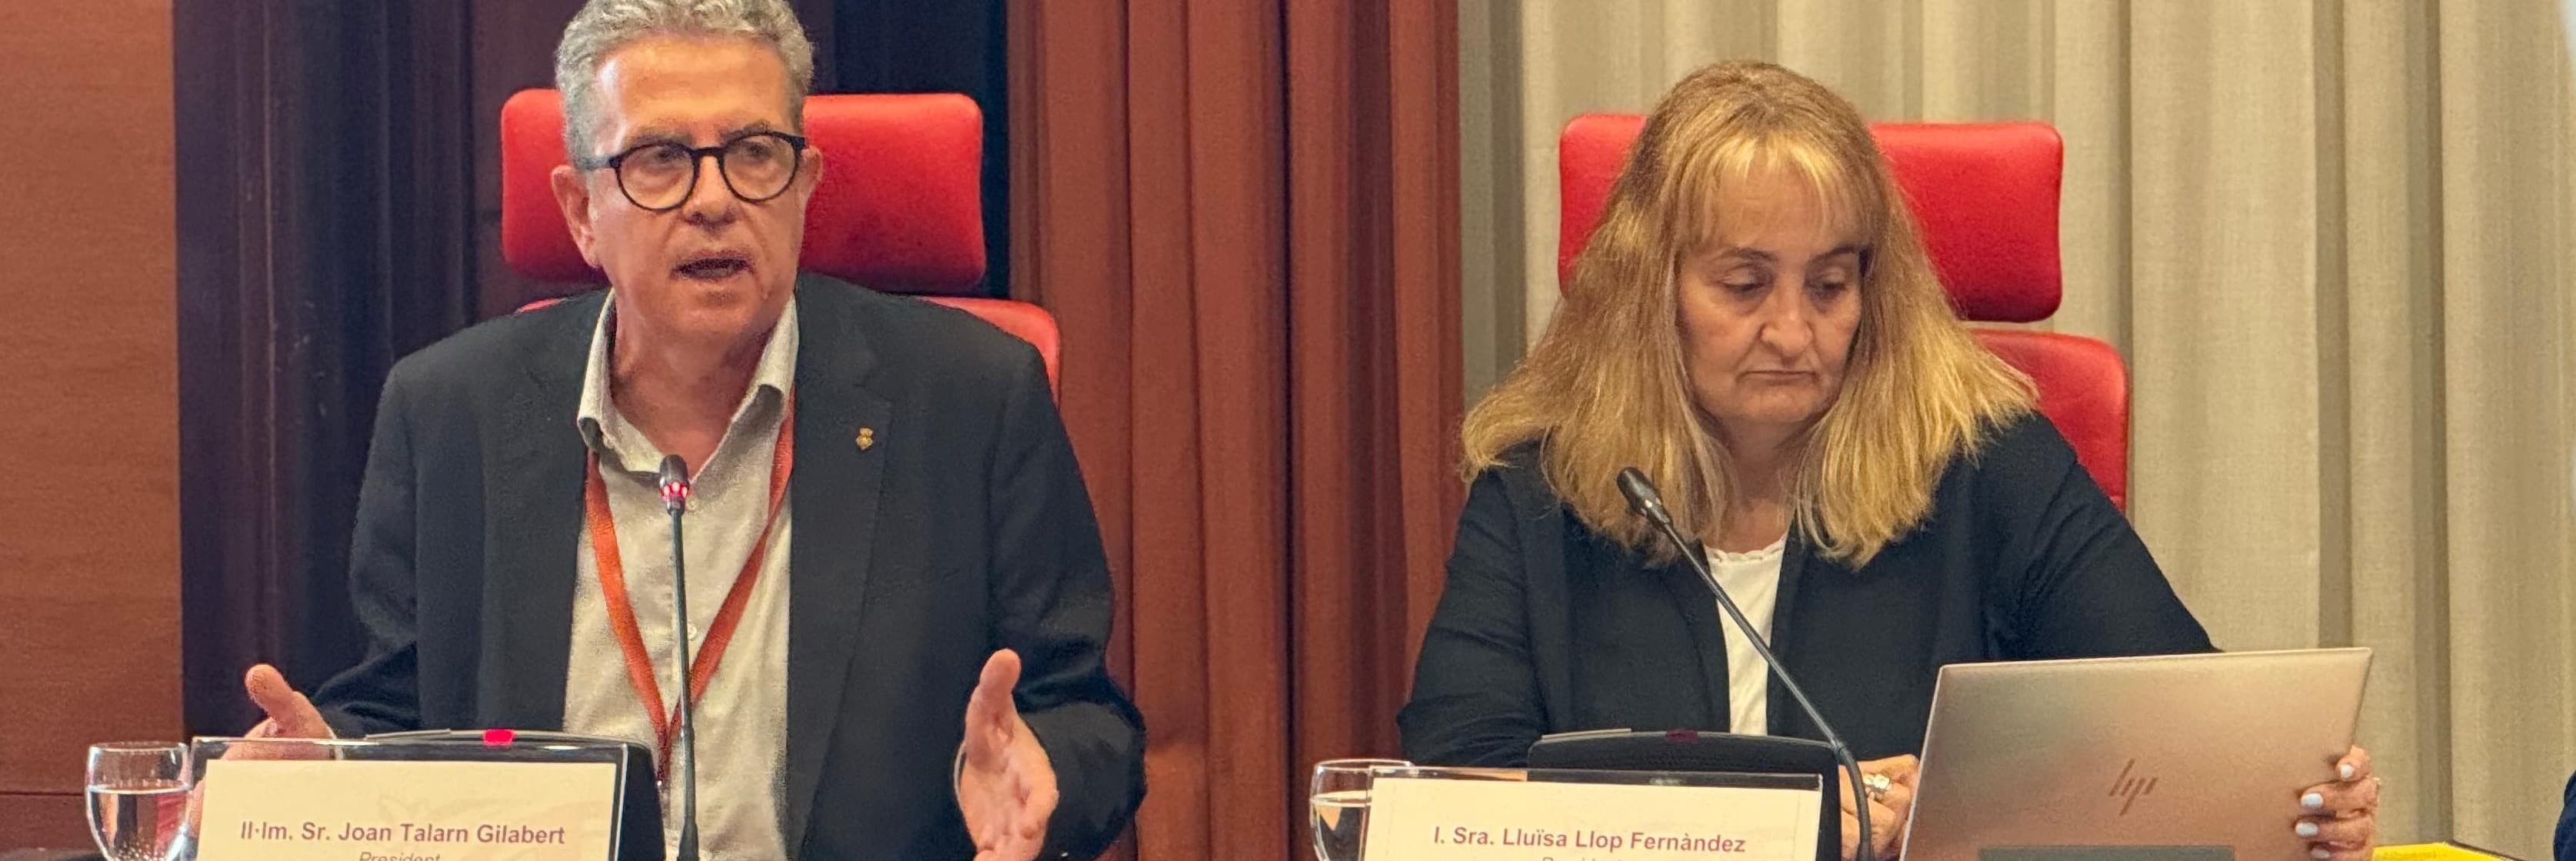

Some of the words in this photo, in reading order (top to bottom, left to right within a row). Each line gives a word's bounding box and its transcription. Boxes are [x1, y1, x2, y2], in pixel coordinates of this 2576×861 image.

[2108, 758, 2158, 816] hp
[301, 821, 331, 841] Sr.
[338, 822, 392, 842] Joan
[399, 823, 468, 843] Talarn
[476, 824, 565, 845] Gilabert
[1452, 826, 1495, 846] Sra.
[1502, 828, 1568, 848] Lluïsa
[1575, 829, 1623, 853] Llop
[1630, 831, 1747, 853] Fernàndez
